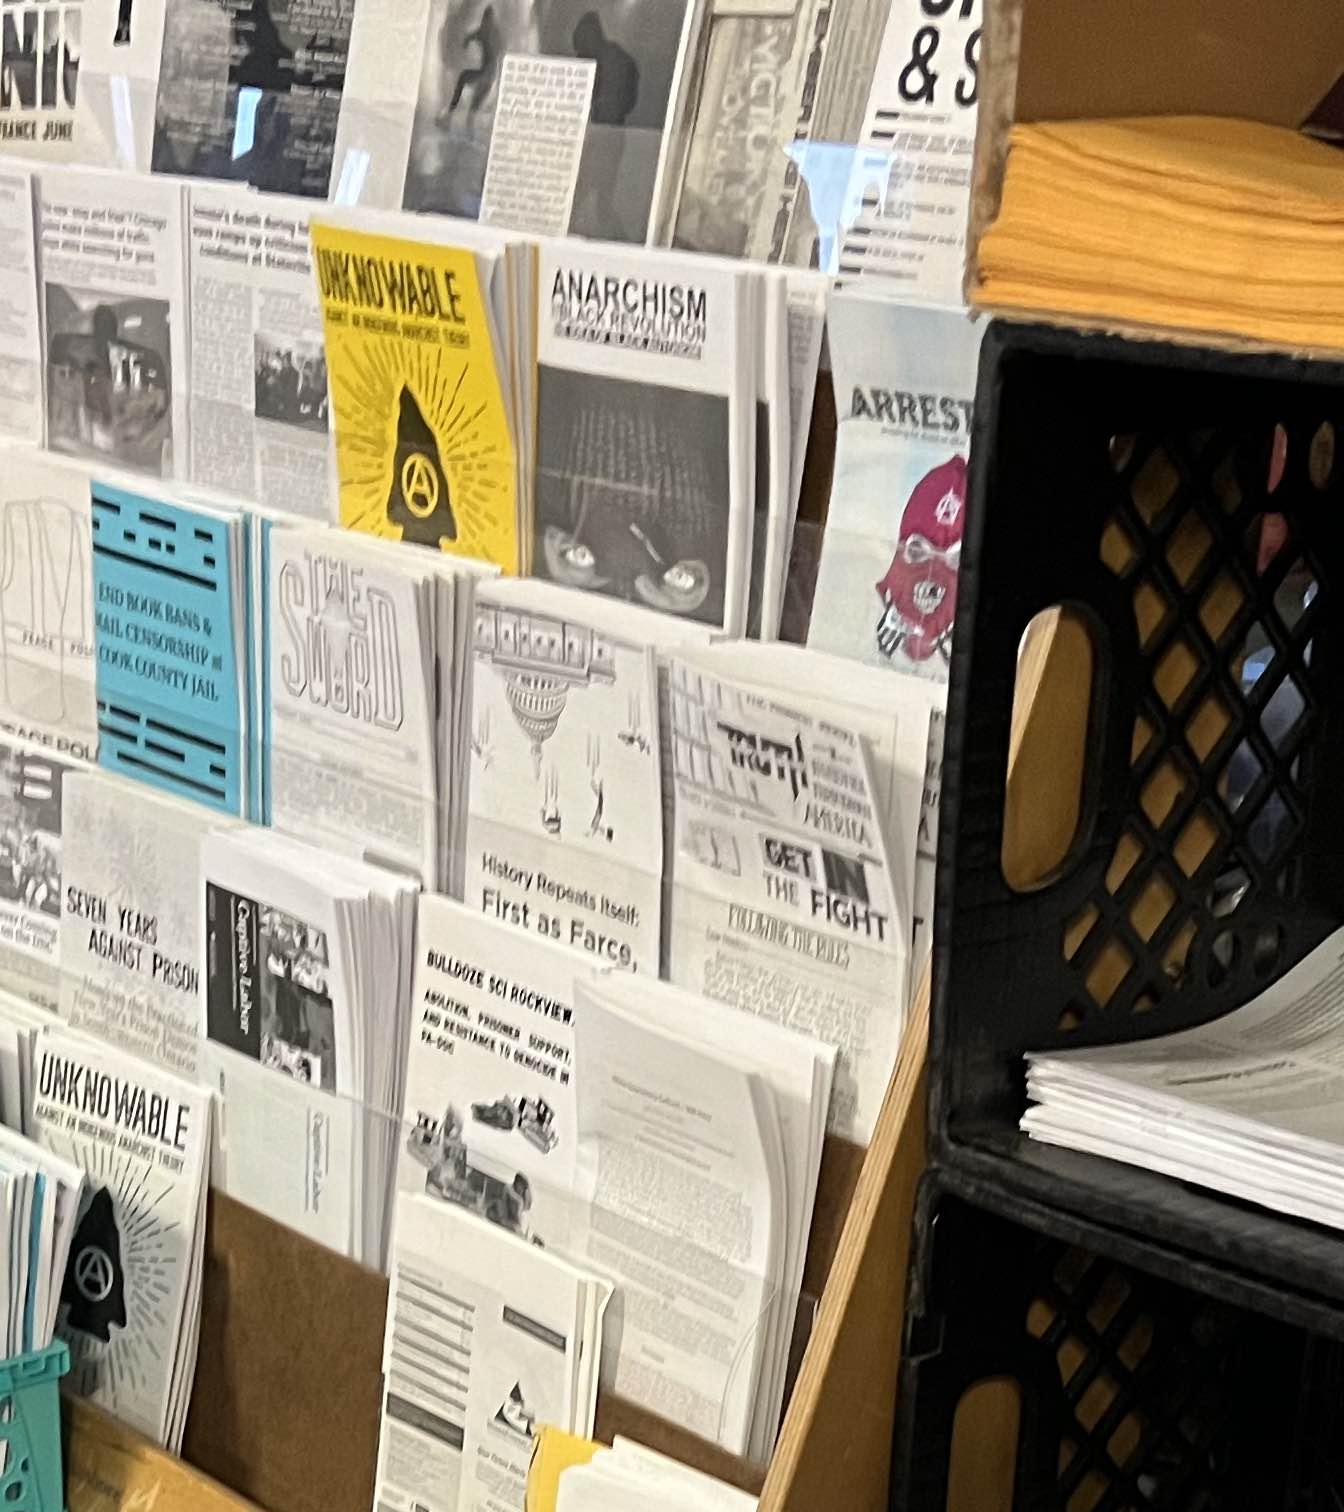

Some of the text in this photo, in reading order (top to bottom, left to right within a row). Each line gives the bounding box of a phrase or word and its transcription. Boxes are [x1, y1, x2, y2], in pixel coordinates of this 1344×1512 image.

[898, 26, 939, 104] &
[316, 246, 467, 325] UNKNOWABLE
[552, 267, 707, 322] ANARCHISM
[850, 383, 974, 434] ARREST
[99, 582, 124, 607] END
[127, 591, 164, 620] BOOK
[165, 602, 201, 632] BANS
[99, 644, 134, 673] COOK
[135, 655, 190, 691] COUNTY
[191, 671, 219, 701] JAIL
[125, 622, 209, 667] CENSORSHIP
[482, 851, 534, 892] History
[536, 871, 597, 912] Repeats
[764, 836, 814, 879] GET
[67, 886, 107, 925] SEVEN
[118, 903, 159, 946] YEARS
[482, 887, 530, 930] First
[537, 912, 561, 940] as
[810, 887, 888, 942] FIGHT
[88, 927, 200, 997] AGAINST PRISON
[426, 949, 576, 1028] BULLDOZE SCI ROCKVIEW,
[422, 1008, 442, 1028] AND
[443, 1017, 497, 1054] RESISTANCE
[499, 1041, 511, 1060] TO
[39, 1050, 191, 1151] UNKNOWABLE
